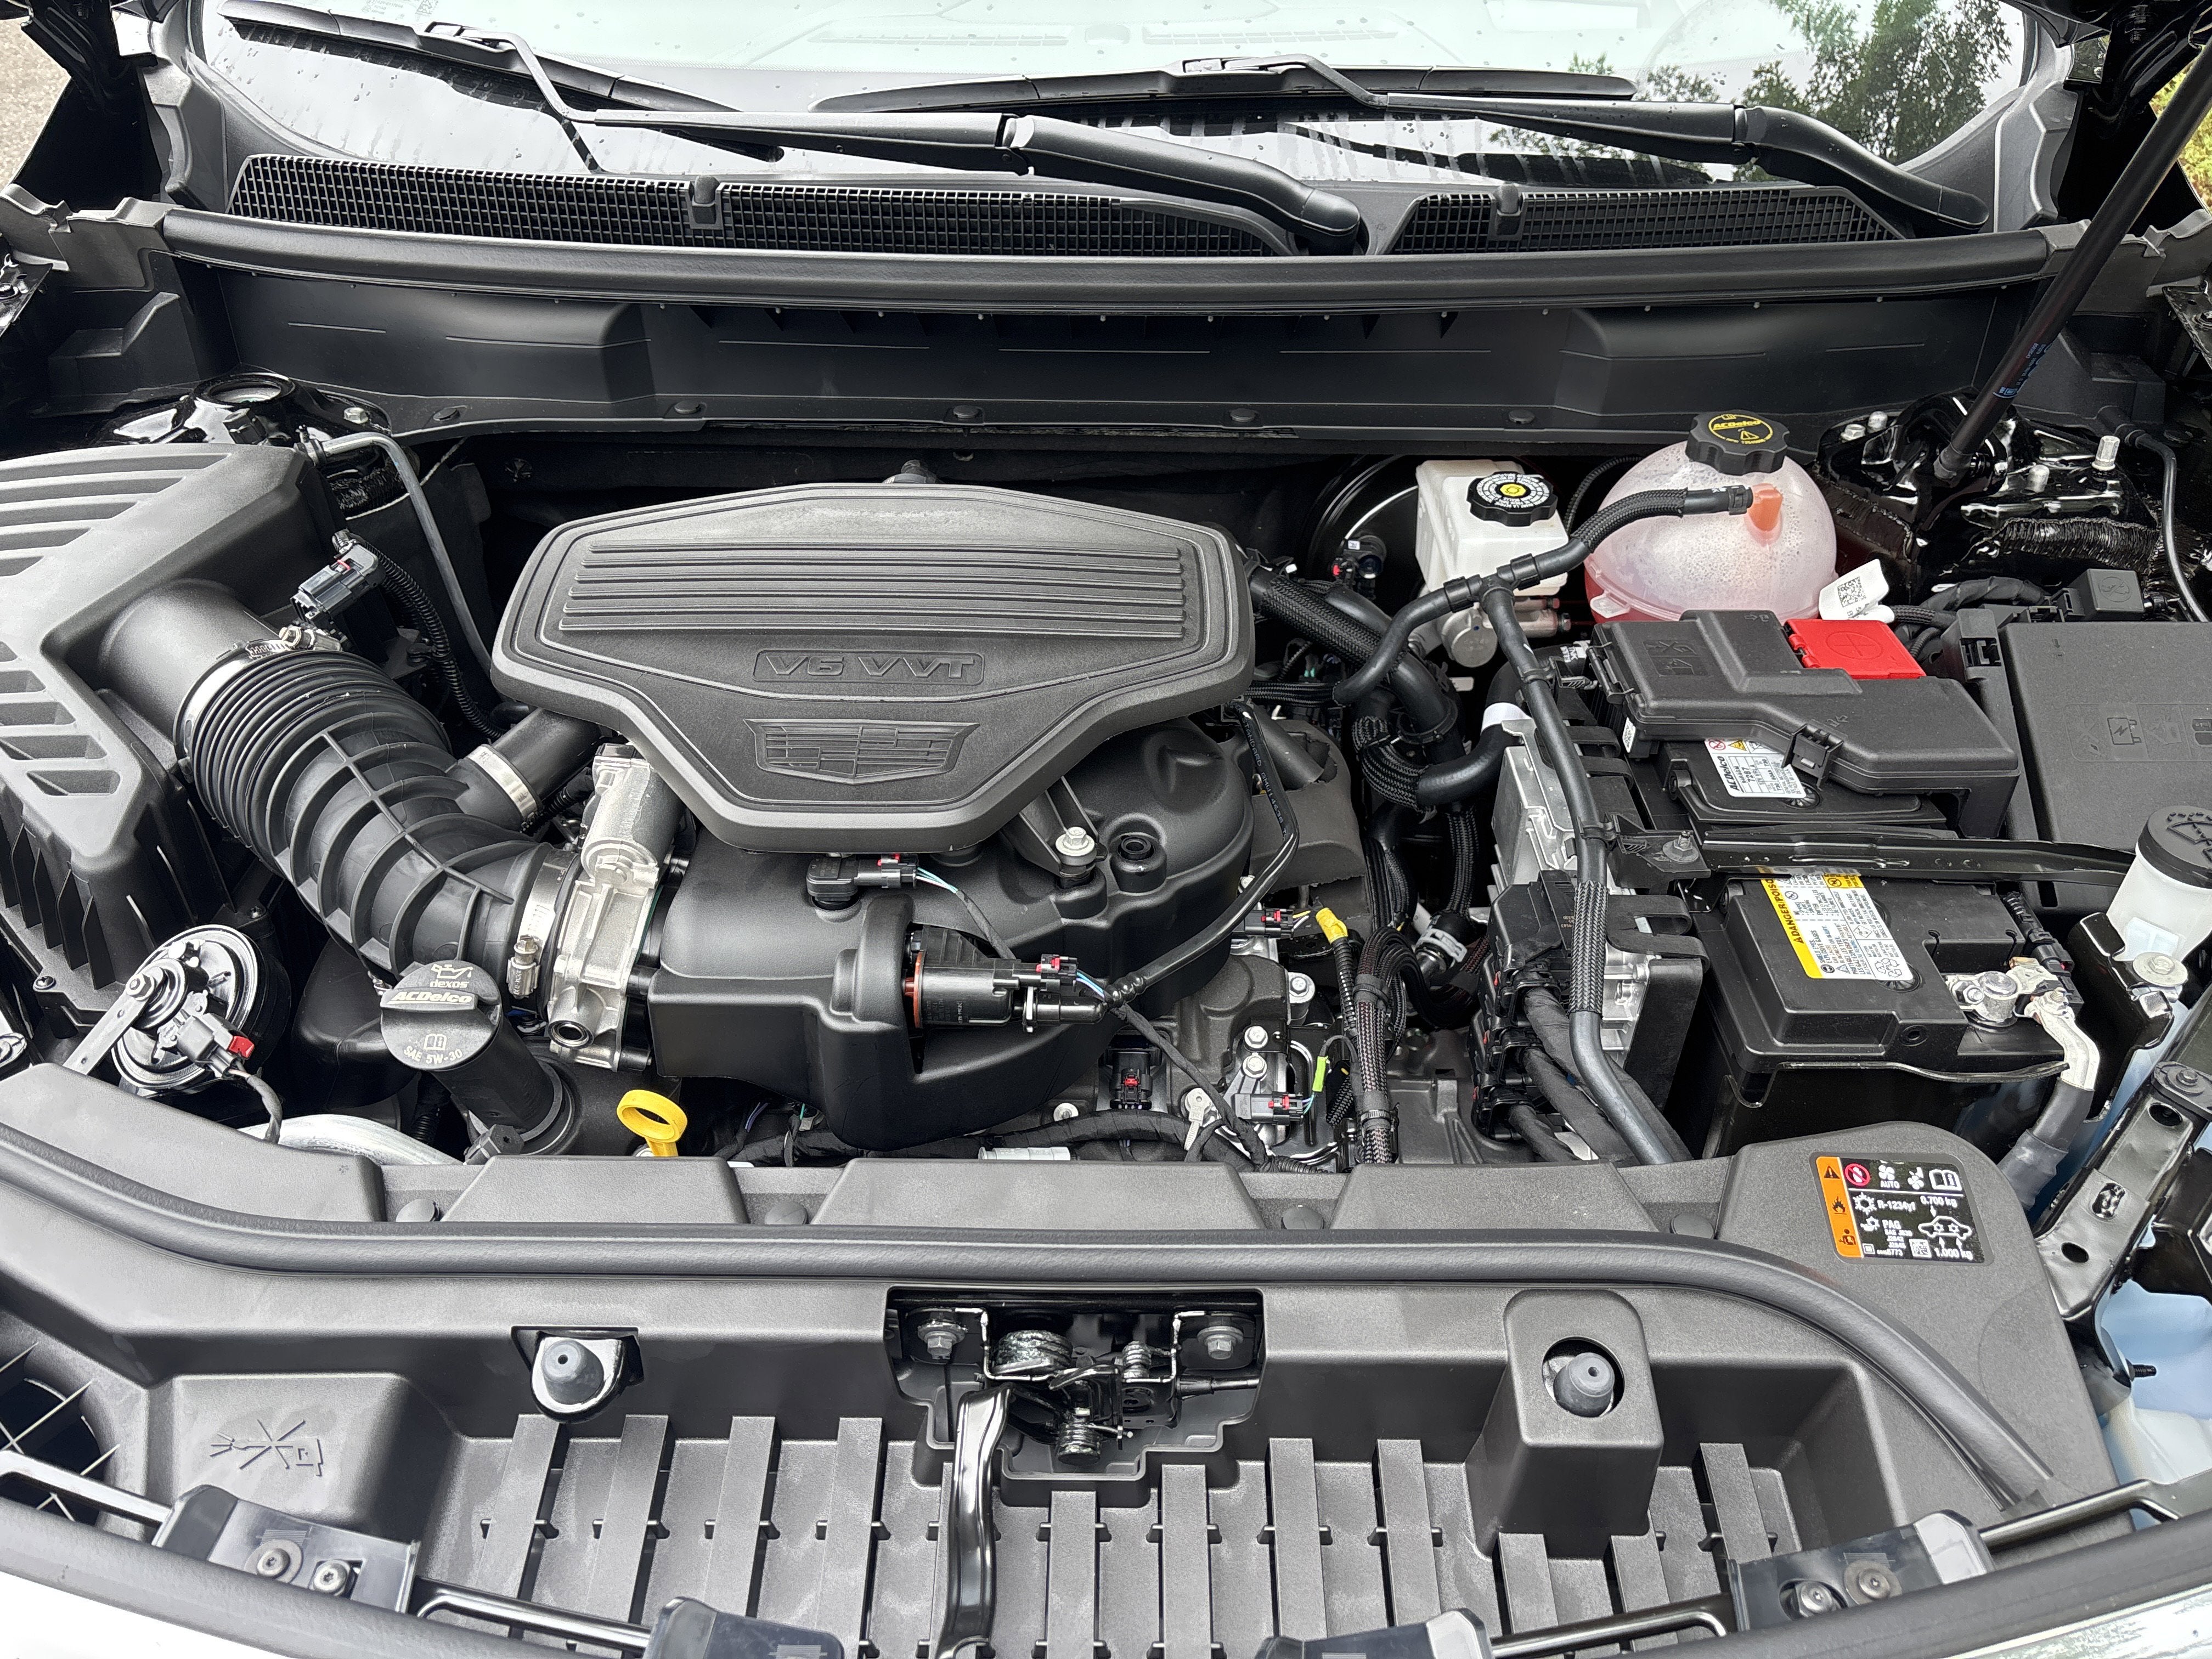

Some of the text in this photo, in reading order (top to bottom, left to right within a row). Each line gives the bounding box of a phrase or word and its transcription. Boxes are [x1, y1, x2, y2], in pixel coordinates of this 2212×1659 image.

[1713, 420, 1761, 428] ACDelco
[766, 656, 974, 679] V6 VVT
[1242, 718, 1262, 766] STANDARD
[1717, 755, 1740, 791] ACDelco
[1741, 767, 1756, 782] 7287
[1765, 878, 1800, 936] DANGER/POISO
[430, 979, 469, 988] dexos
[391, 991, 473, 1003] ACDelco
[403, 1046, 462, 1064] SAE 5W-30
[1880, 1181, 1900, 1189] AUTO
[1877, 1200, 1916, 1212] R-1234yf
[1920, 1196, 1958, 1208] 0.700 kg
[1882, 1220, 1901, 1229] PAG
[1934, 1248, 1973, 1261] 1.000 kg
